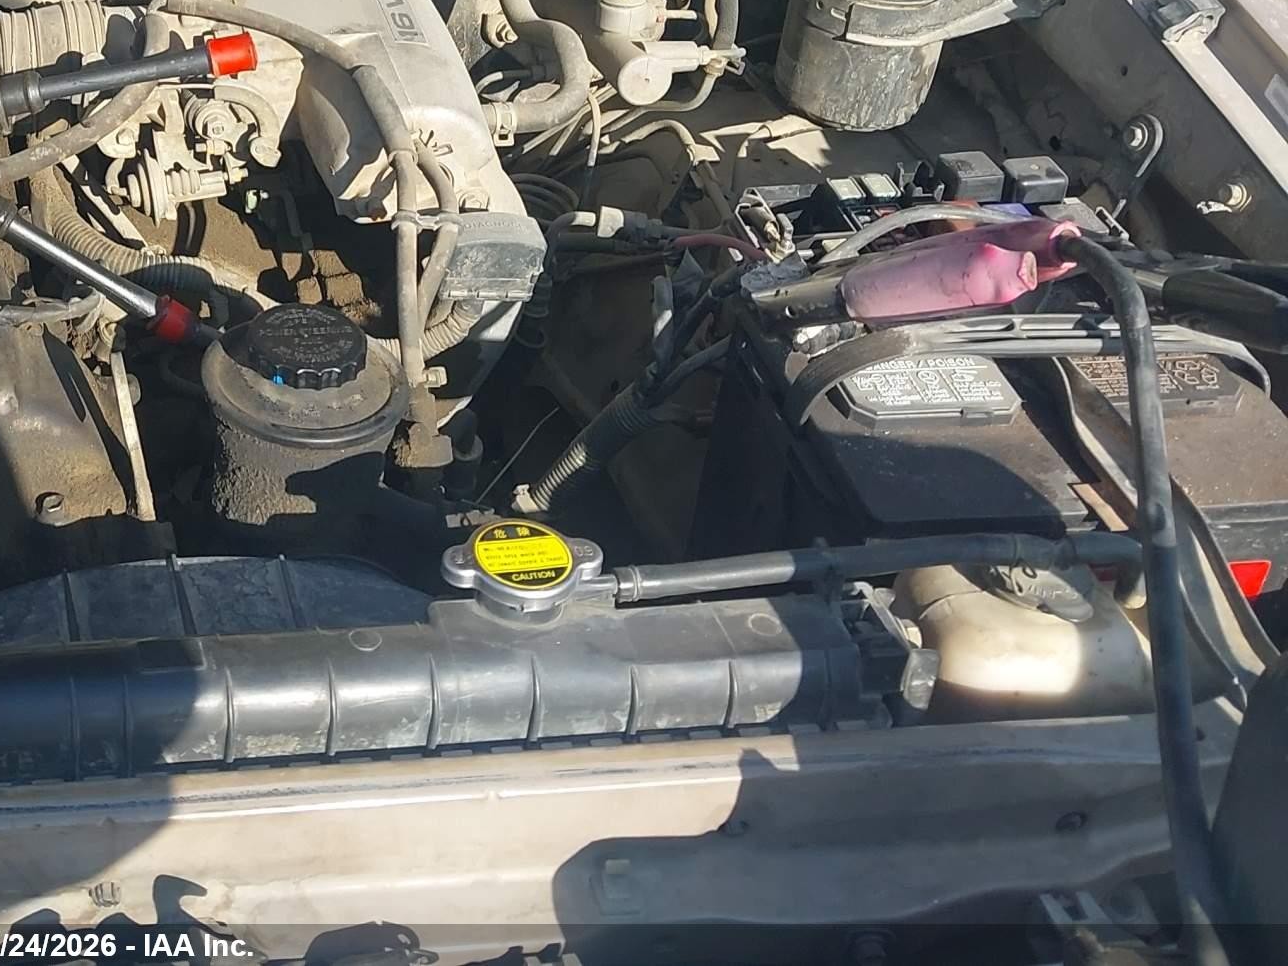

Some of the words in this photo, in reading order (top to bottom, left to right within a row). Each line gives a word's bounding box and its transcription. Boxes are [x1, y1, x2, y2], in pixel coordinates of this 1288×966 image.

[394, 12, 420, 39] 16
[927, 357, 976, 368] POISON
[511, 570, 556, 581] CAUTION
